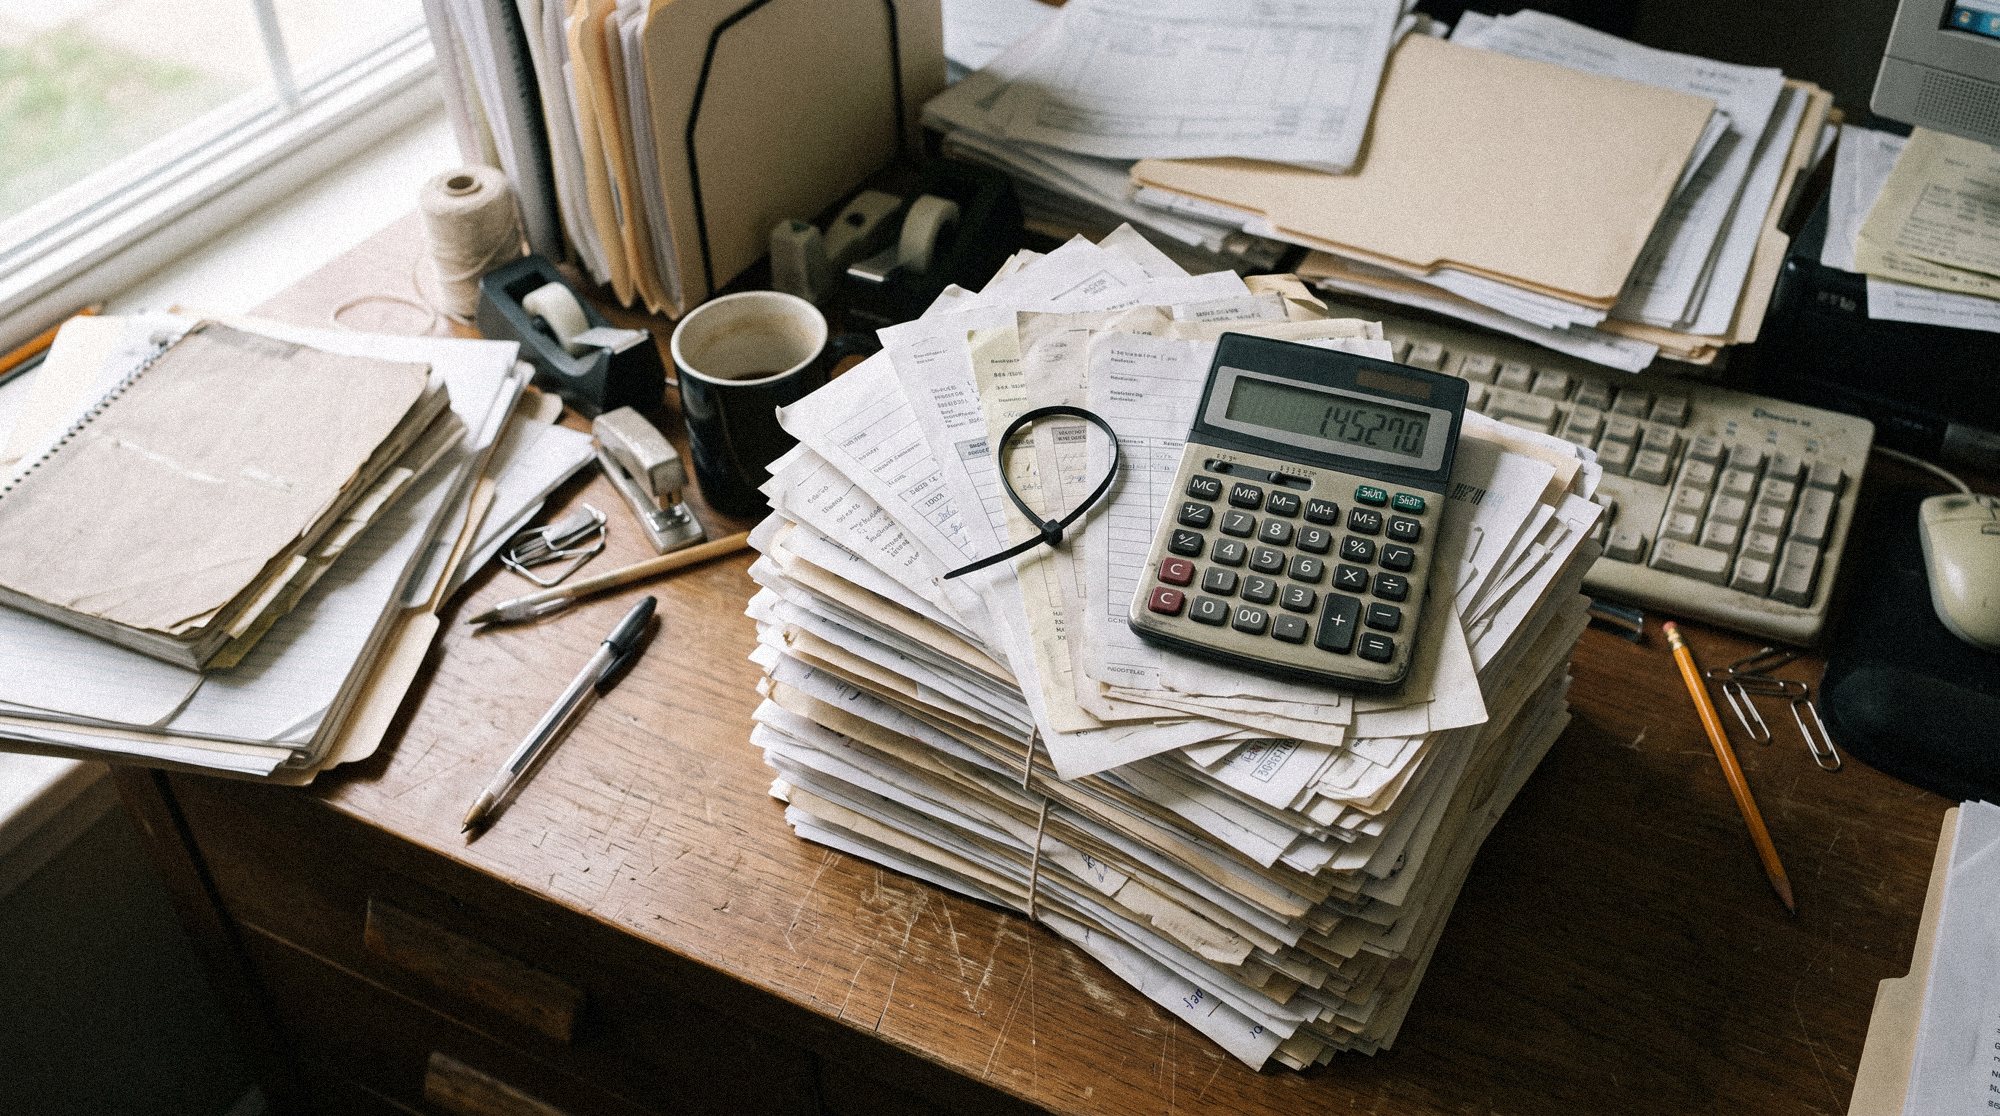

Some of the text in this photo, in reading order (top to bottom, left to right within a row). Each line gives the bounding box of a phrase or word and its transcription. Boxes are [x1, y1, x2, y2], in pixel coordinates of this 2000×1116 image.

[1192, 479, 1217, 492] MC
[1234, 487, 1258, 500] MR
[1310, 502, 1334, 516] M+
[1233, 514, 1320, 543] 7 8 9
[1393, 521, 1415, 533] GT
[1170, 563, 1183, 576] C
[1222, 543, 1313, 573] 4 5 6
[1160, 592, 1174, 605] C
[1217, 572, 1304, 602] 1 2 3
[1202, 601, 1215, 614] 0
[1239, 609, 1261, 624] 00
